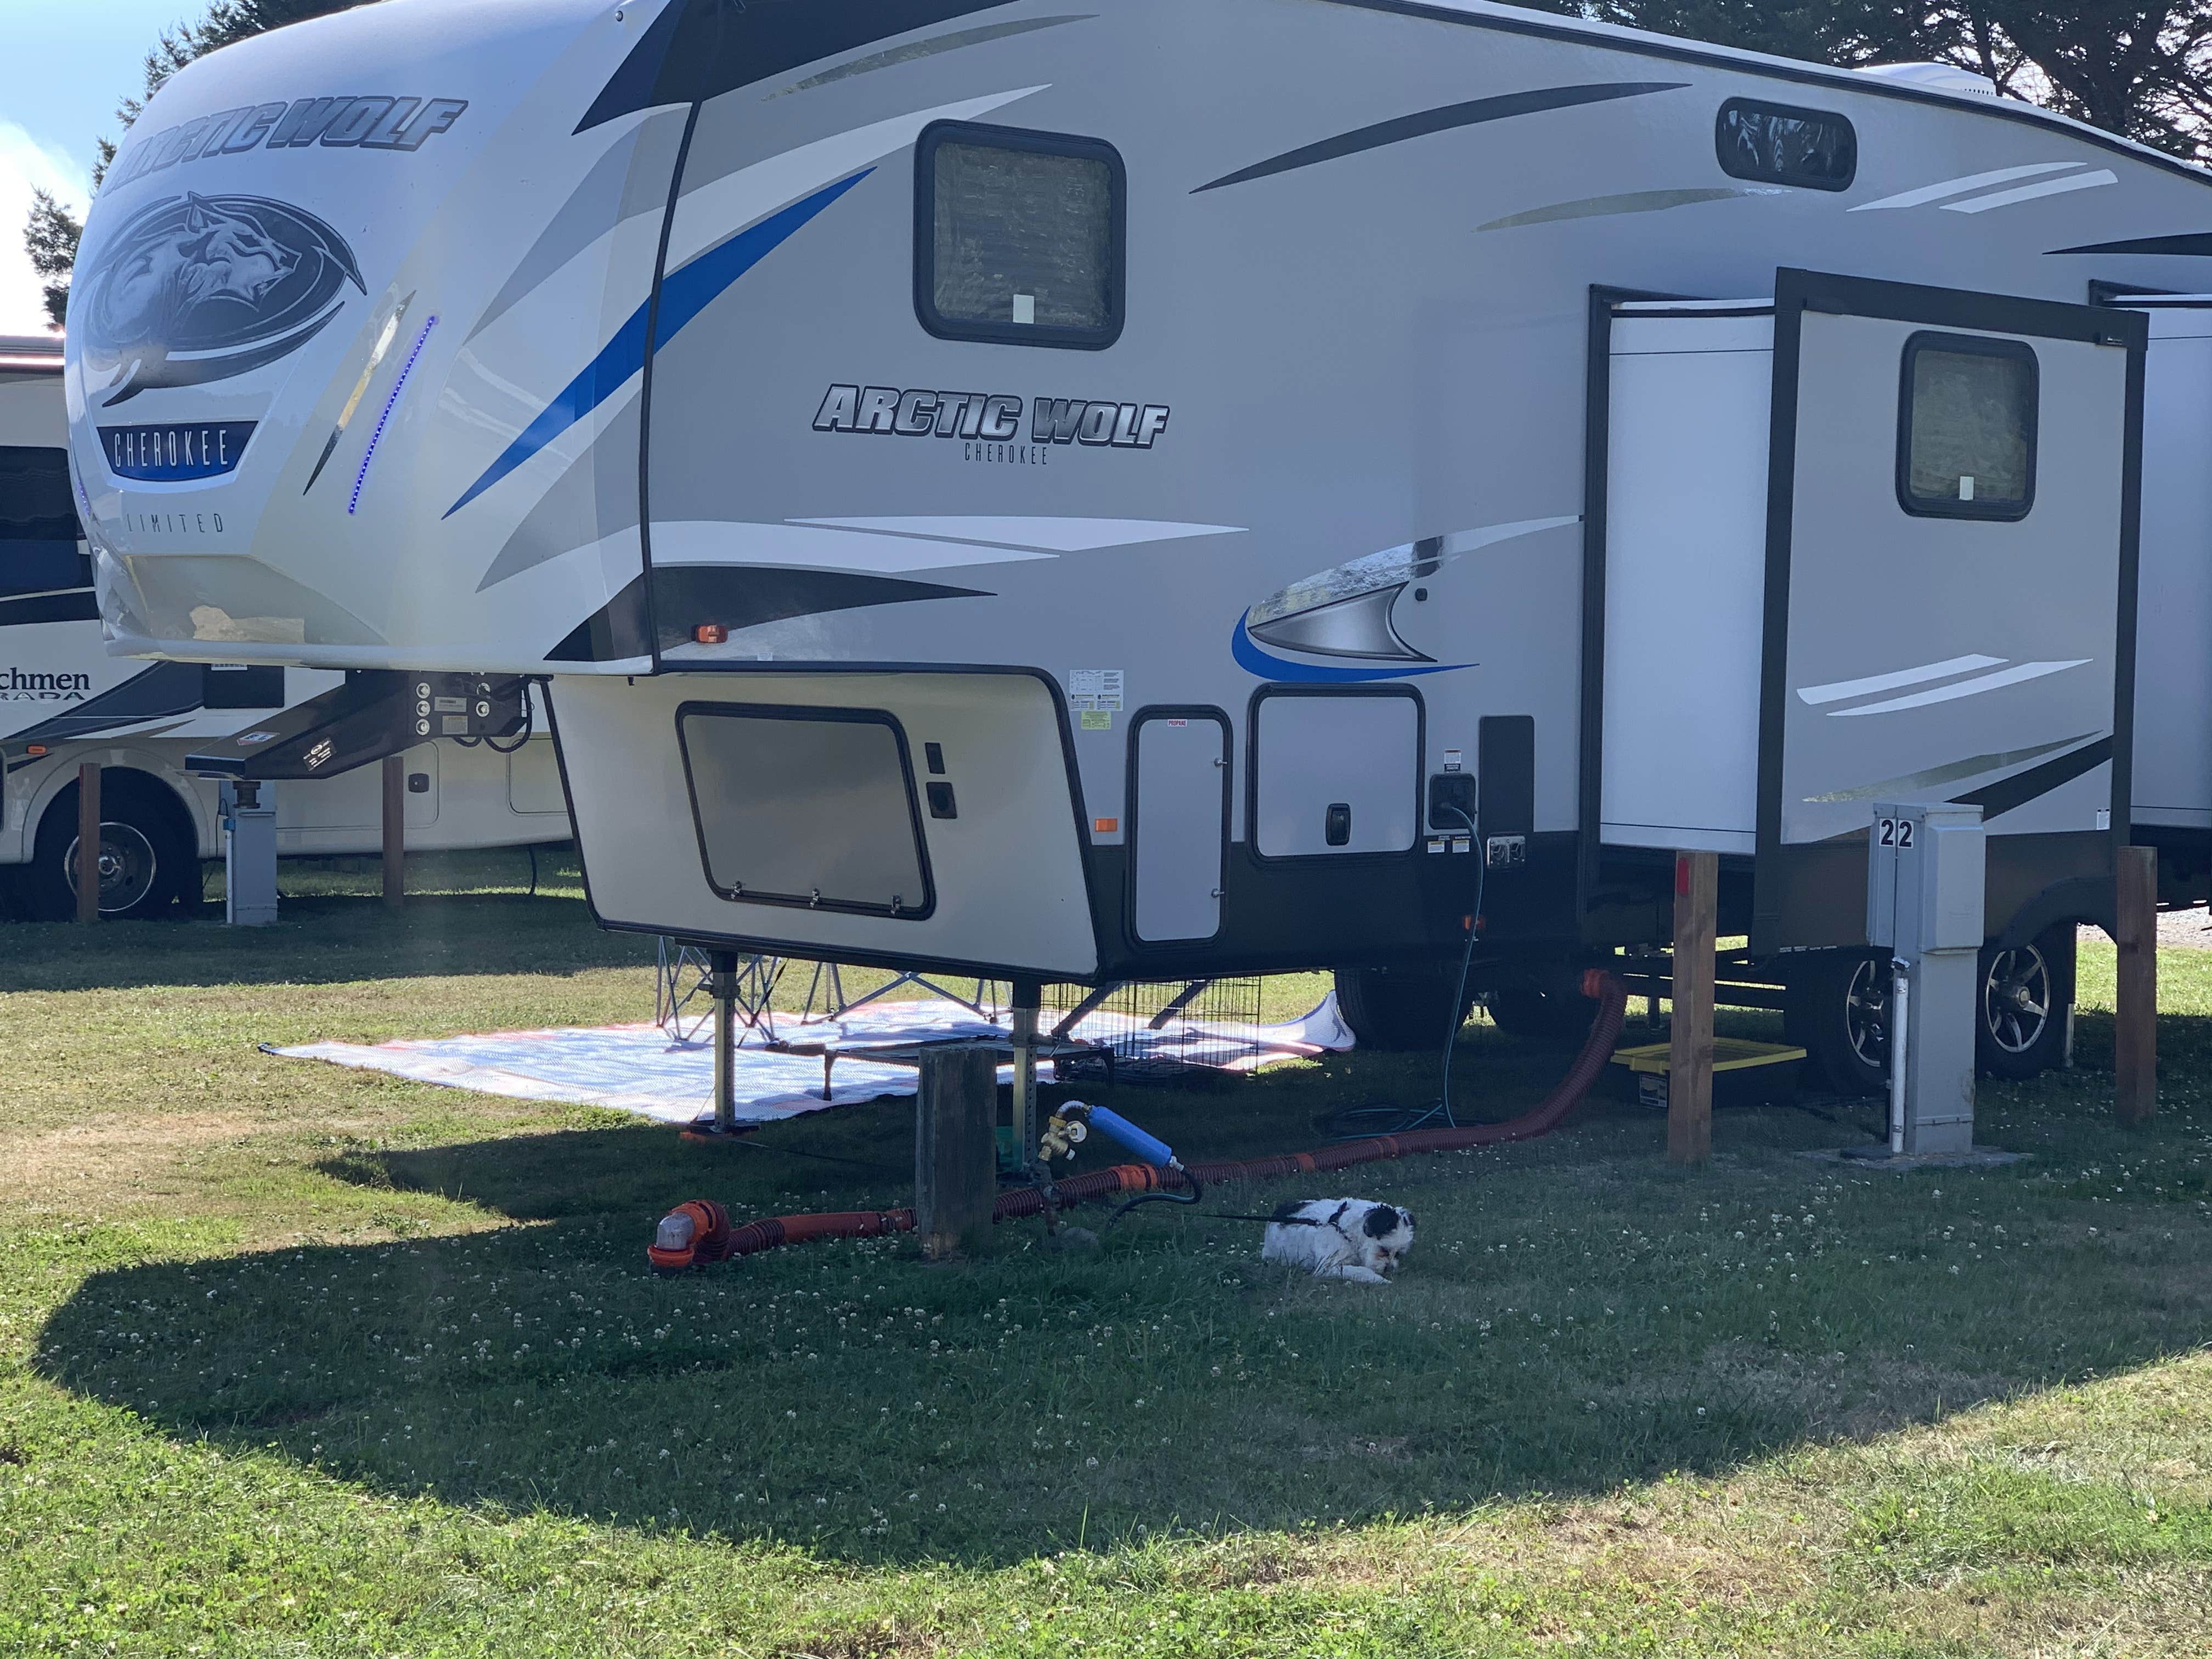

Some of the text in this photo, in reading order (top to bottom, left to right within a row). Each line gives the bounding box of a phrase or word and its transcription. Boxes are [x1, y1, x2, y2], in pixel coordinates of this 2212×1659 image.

[103, 95, 469, 198] ARCTIC WOLF
[812, 383, 1170, 449] ARCTIC WOLF
[114, 430, 228, 467] CHEROKEE
[964, 442, 1047, 465] CHEROKEE
[126, 513, 223, 533] LIMITED
[0, 667, 91, 690] chmen
[1881, 819, 1912, 848] 22
